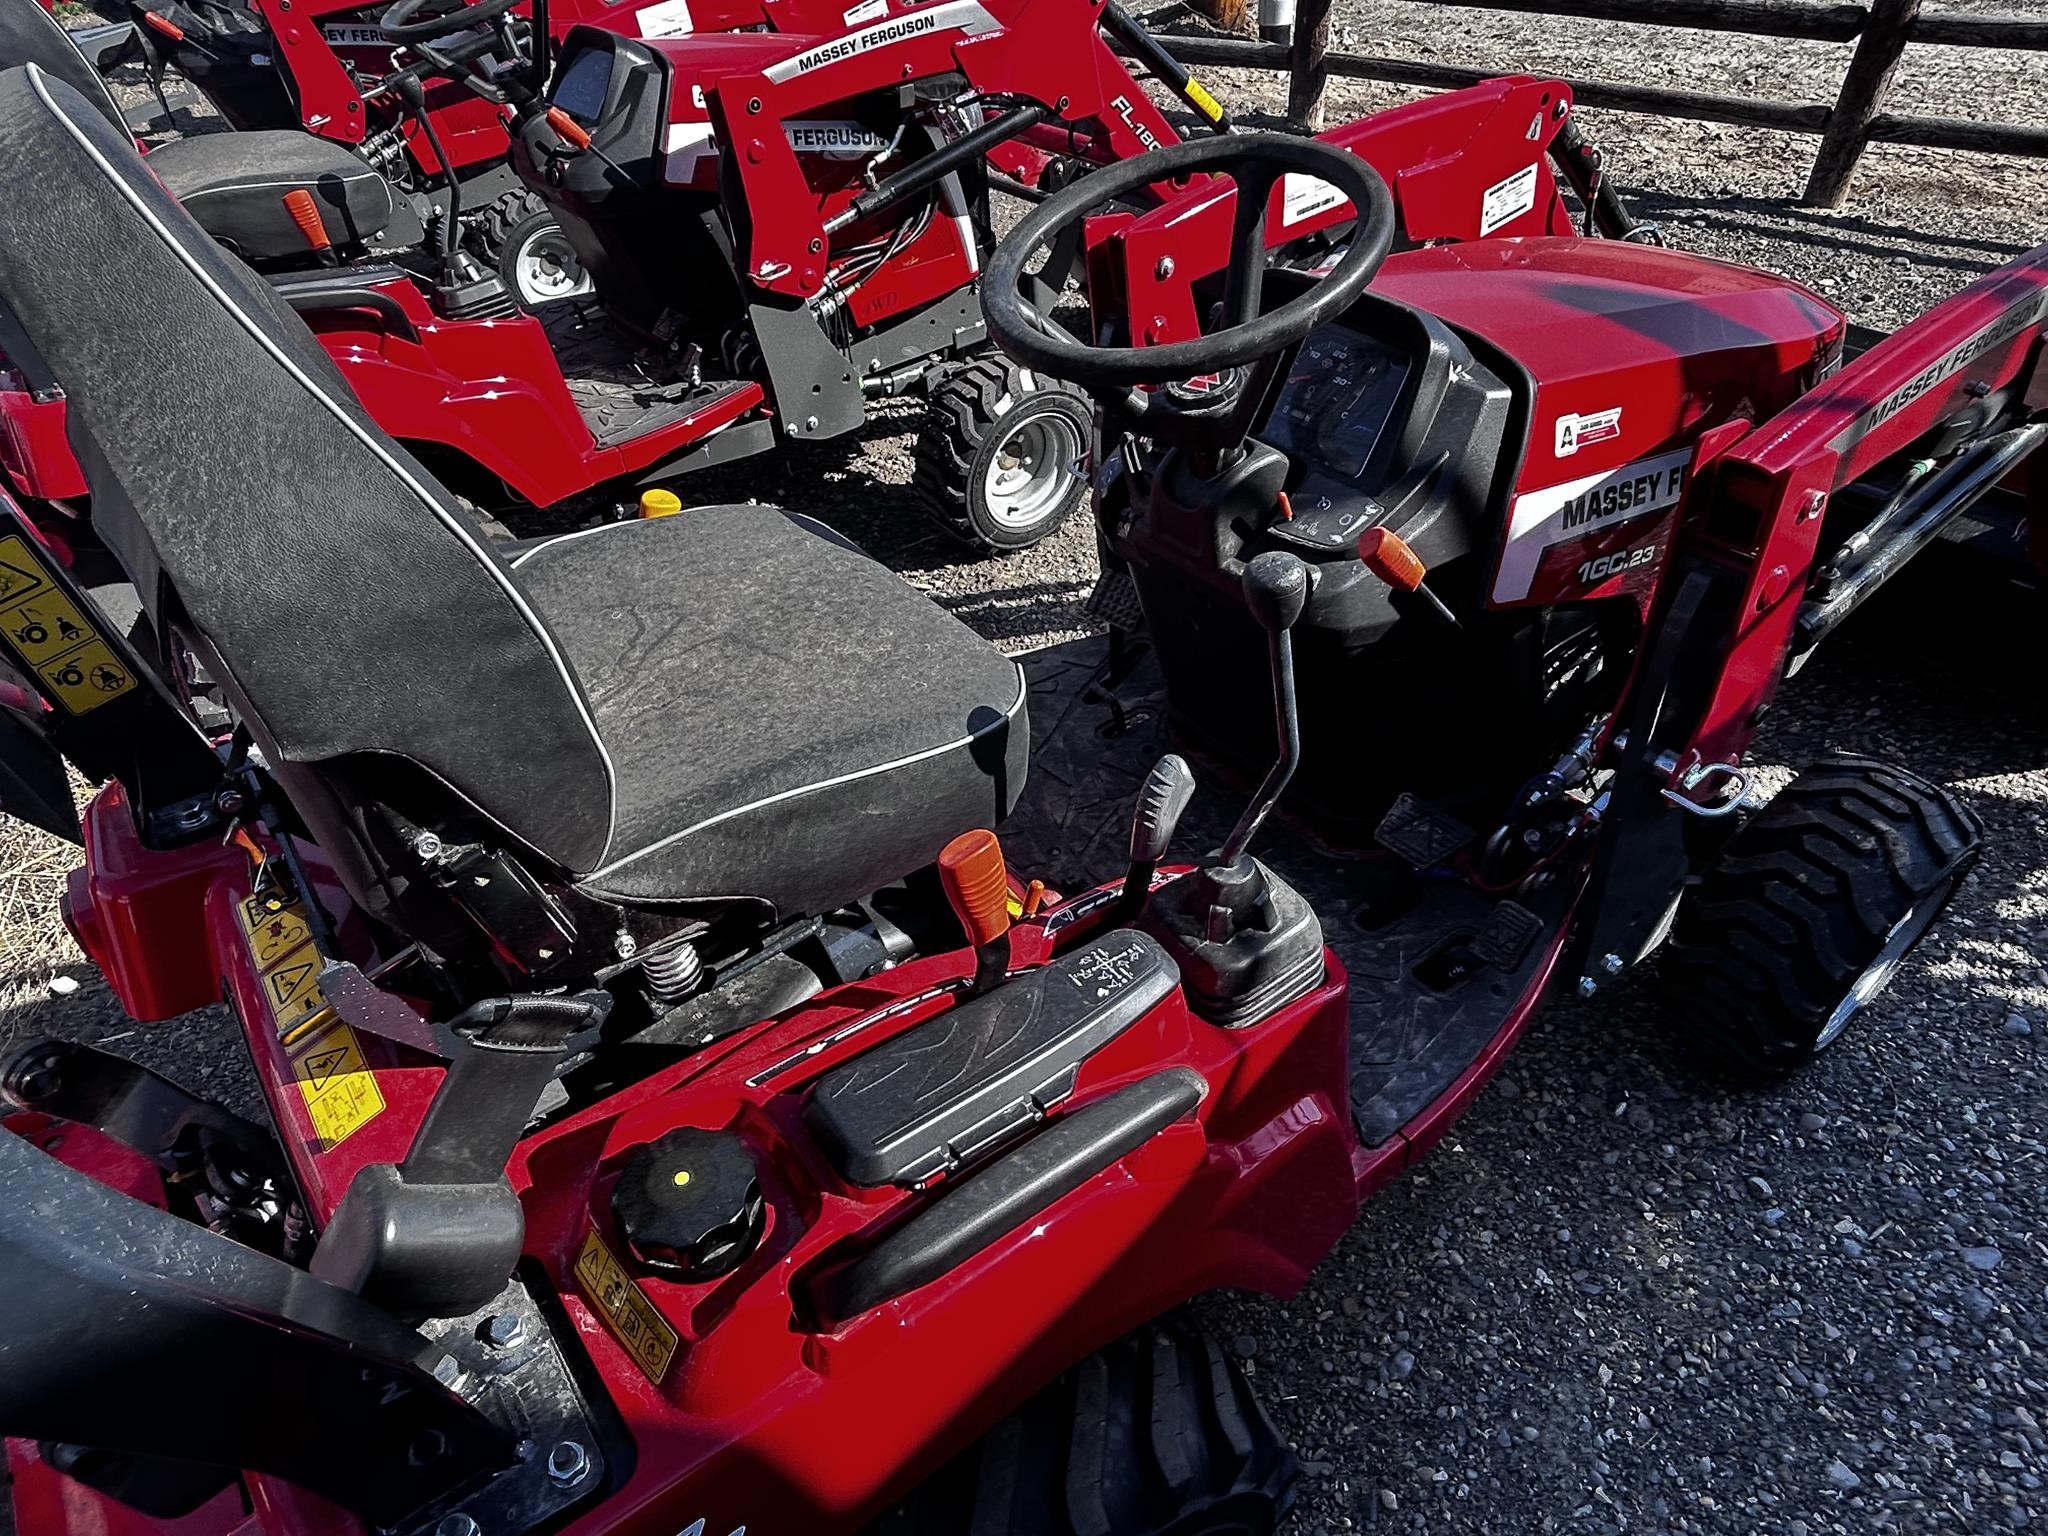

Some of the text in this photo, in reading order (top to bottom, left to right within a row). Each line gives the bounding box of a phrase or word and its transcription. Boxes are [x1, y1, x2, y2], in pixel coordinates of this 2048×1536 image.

[798, 38, 858, 72] MASSEY
[861, 14, 936, 49] FERGUSON
[1867, 295, 2045, 432] MASSEY FERGUSON
[1562, 471, 1662, 530] MASSEY
[1578, 545, 1656, 584] 1GC.23
